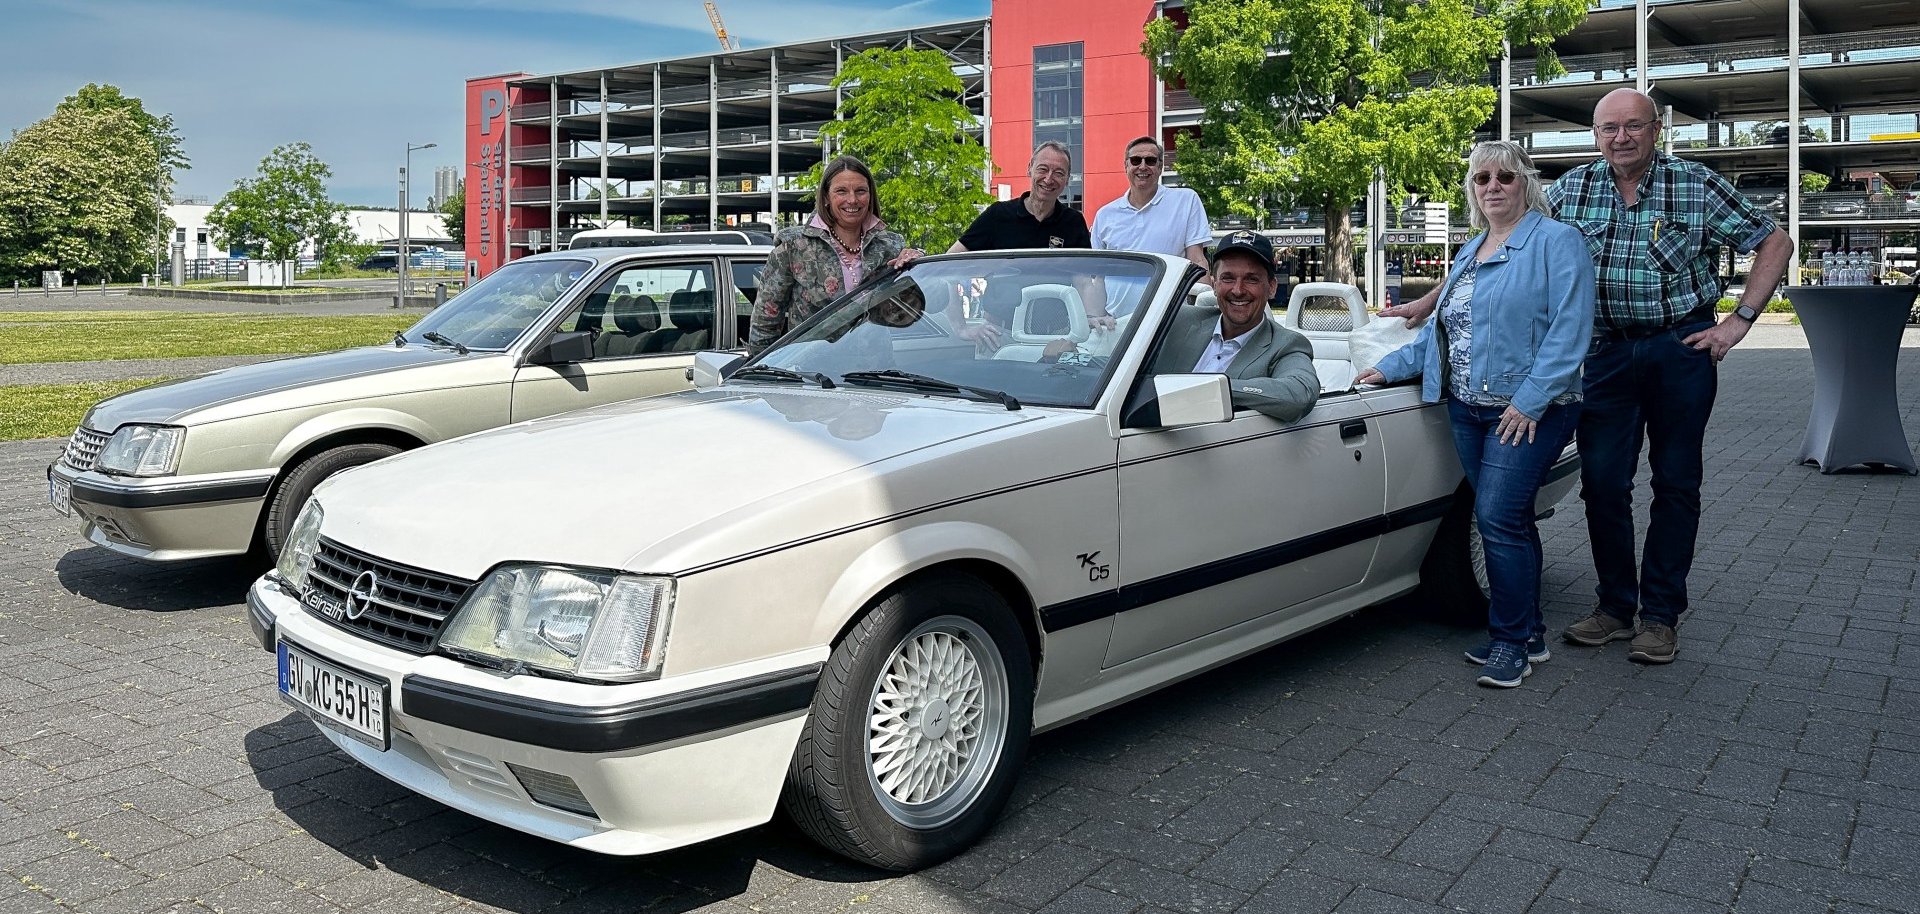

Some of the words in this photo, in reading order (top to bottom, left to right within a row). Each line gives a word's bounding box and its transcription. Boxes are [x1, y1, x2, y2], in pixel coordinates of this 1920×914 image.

[481, 90, 505, 135] P
[493, 142, 502, 169] an
[481, 143, 490, 256] Stadthalle
[494, 176, 503, 211] der
[1408, 233, 1425, 243] Ein
[1090, 565, 1110, 581] C5
[301, 584, 344, 620] Keinath
[289, 652, 303, 696] GV
[313, 665, 331, 709] KC
